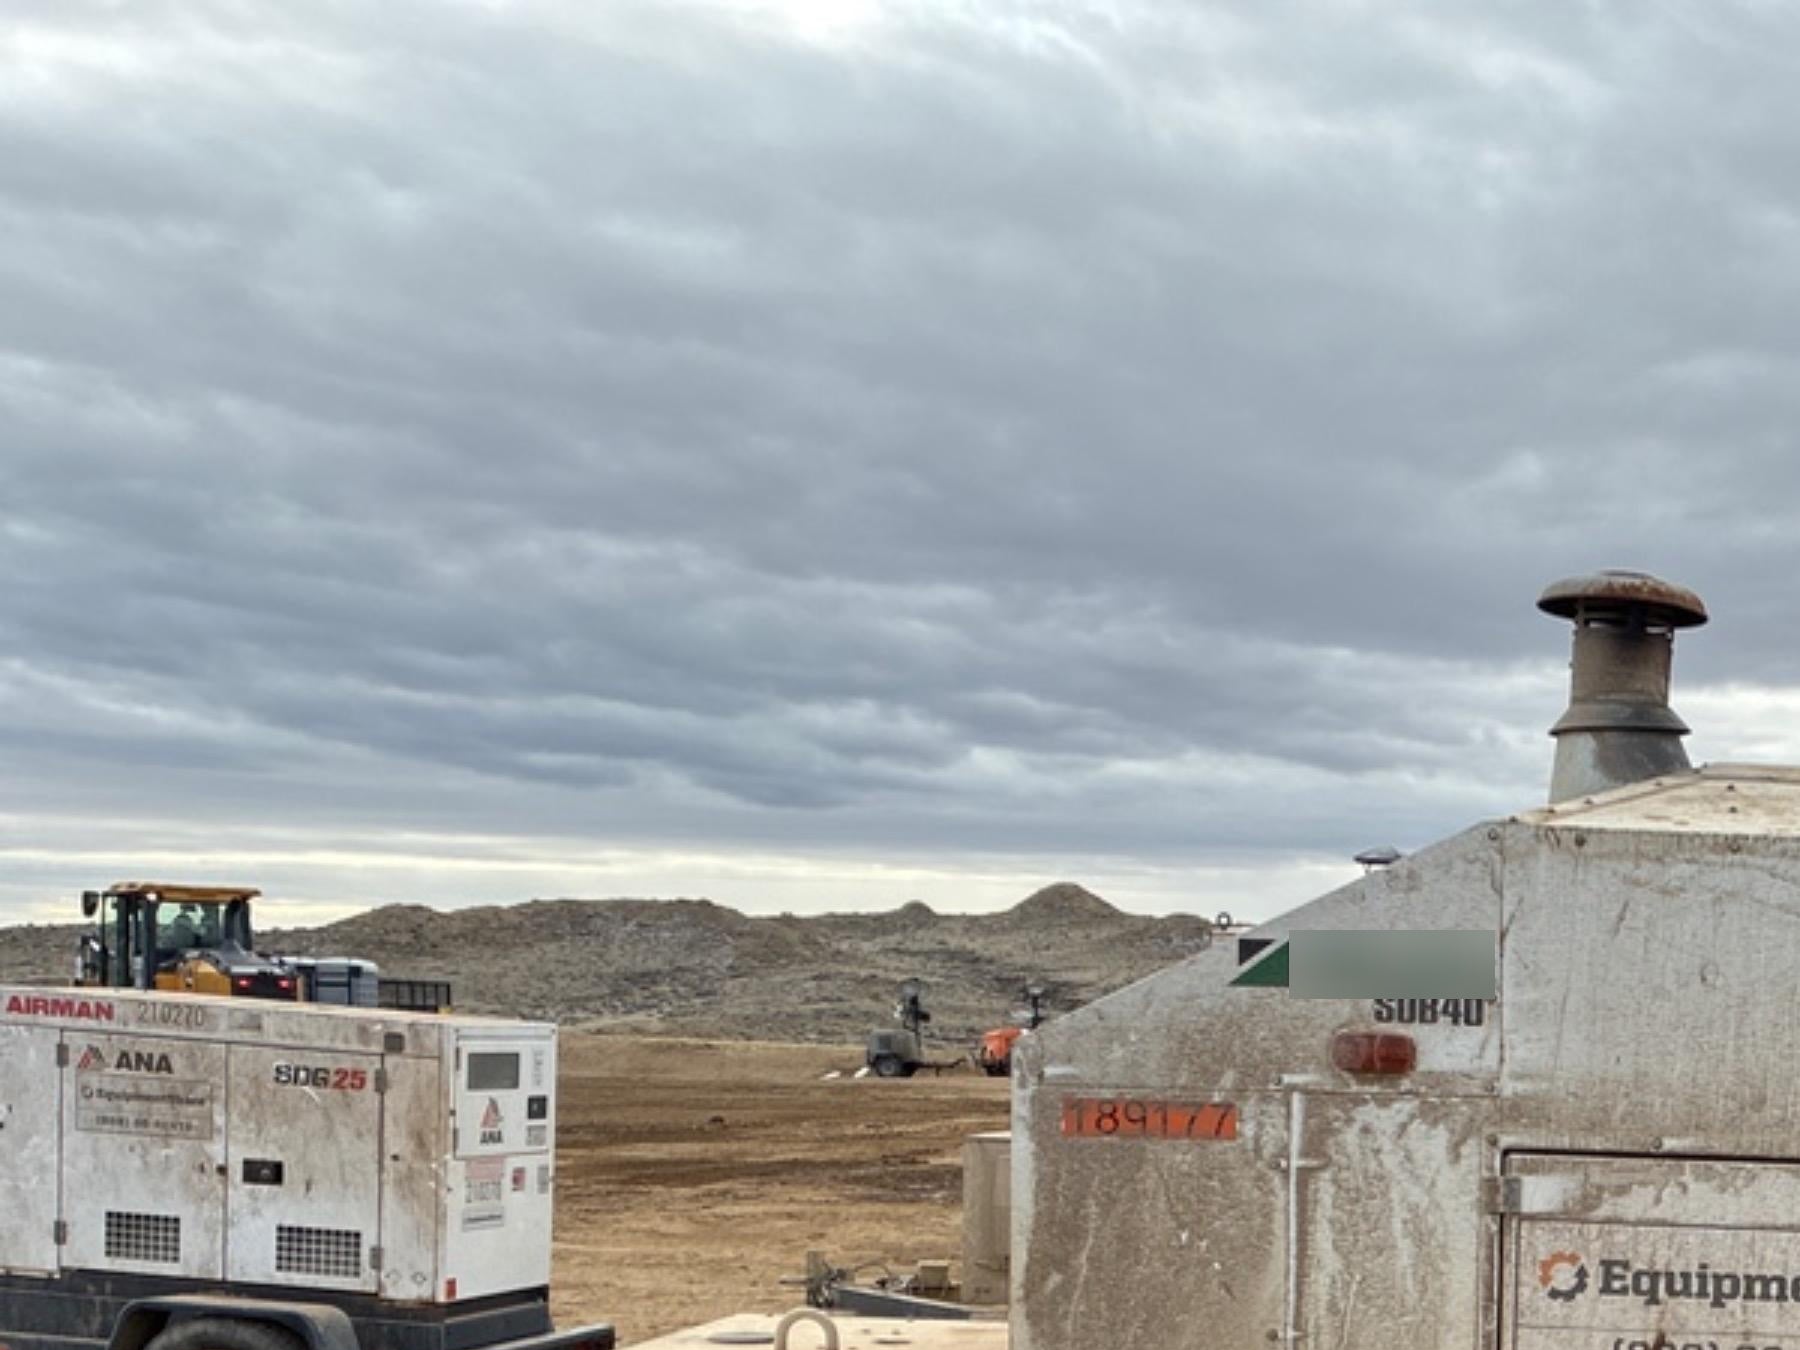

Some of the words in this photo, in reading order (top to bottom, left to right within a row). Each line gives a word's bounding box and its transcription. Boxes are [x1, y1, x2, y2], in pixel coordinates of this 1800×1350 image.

[6, 995, 114, 1021] AIRMAN
[115, 1051, 173, 1074] ANA
[1064, 1099, 1237, 1139] 189177
